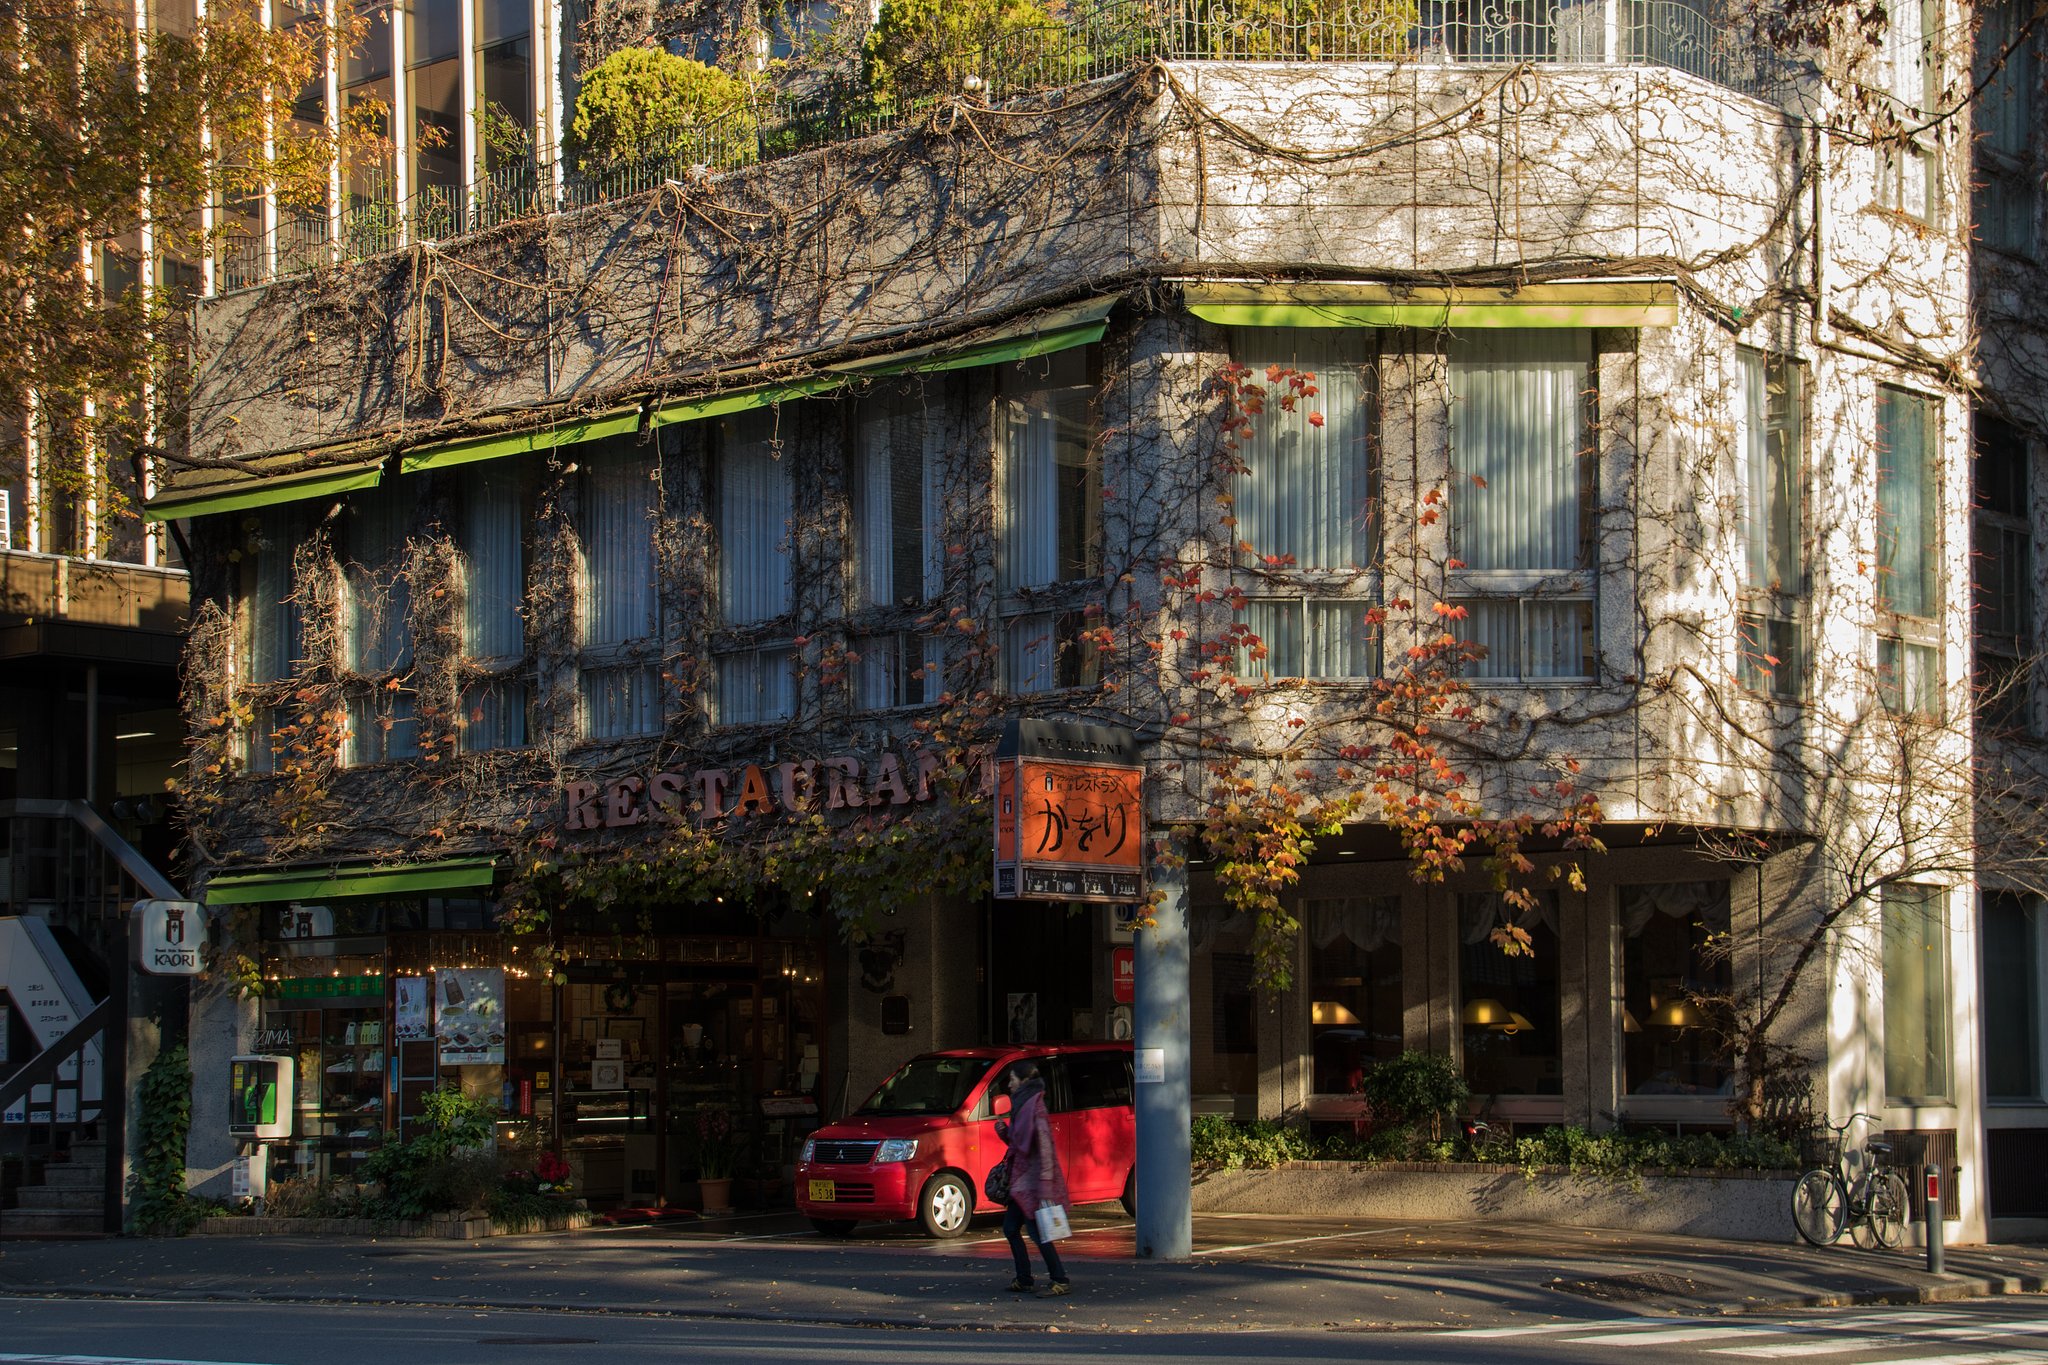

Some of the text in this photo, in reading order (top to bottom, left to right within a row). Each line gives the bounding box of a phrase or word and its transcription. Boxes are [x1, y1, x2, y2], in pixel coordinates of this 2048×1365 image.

[1037, 736, 1122, 754] RESTAURANT
[1075, 779, 1119, 793] レストラン
[1036, 798, 1126, 858] かをり
[155, 953, 194, 967] KAORI
